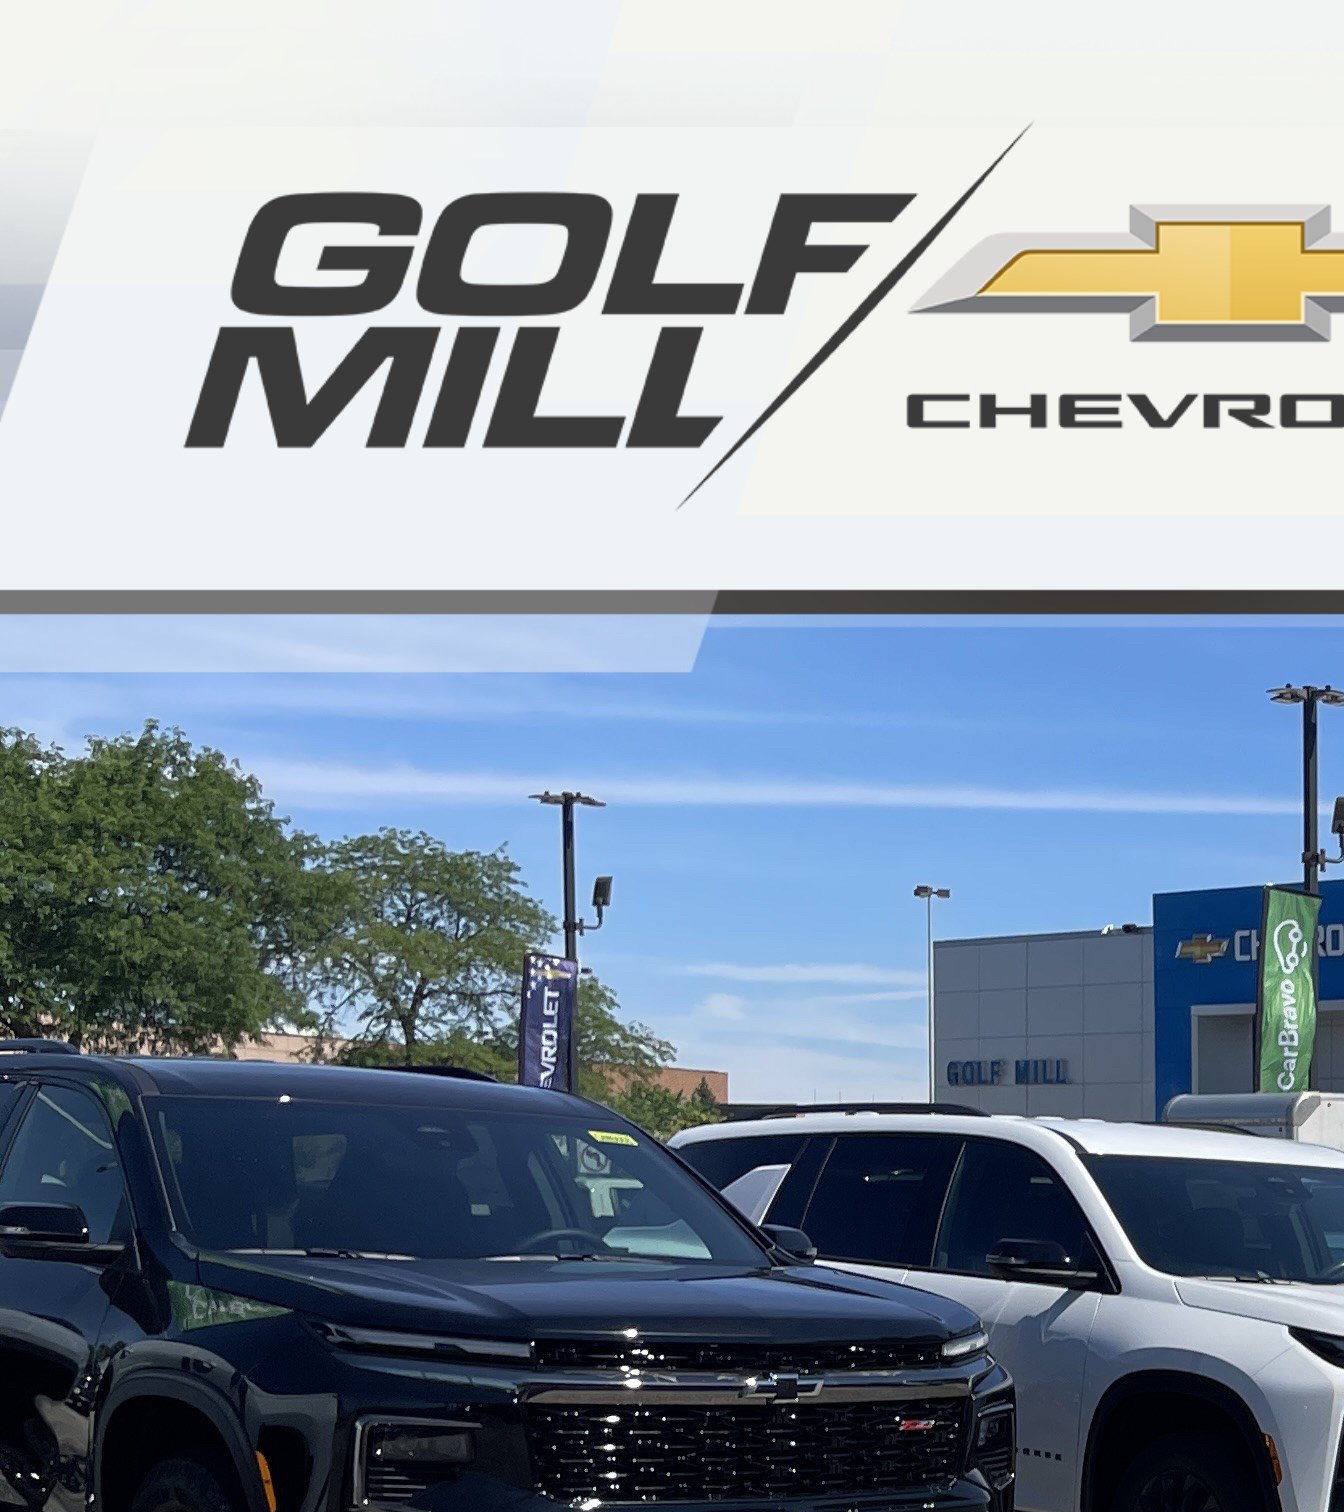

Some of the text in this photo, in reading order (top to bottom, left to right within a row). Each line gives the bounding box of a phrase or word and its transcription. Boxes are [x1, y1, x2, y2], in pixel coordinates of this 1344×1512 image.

[1276, 978, 1299, 1091] CarBravo
[947, 1060, 1071, 1085] GOLF MILL
